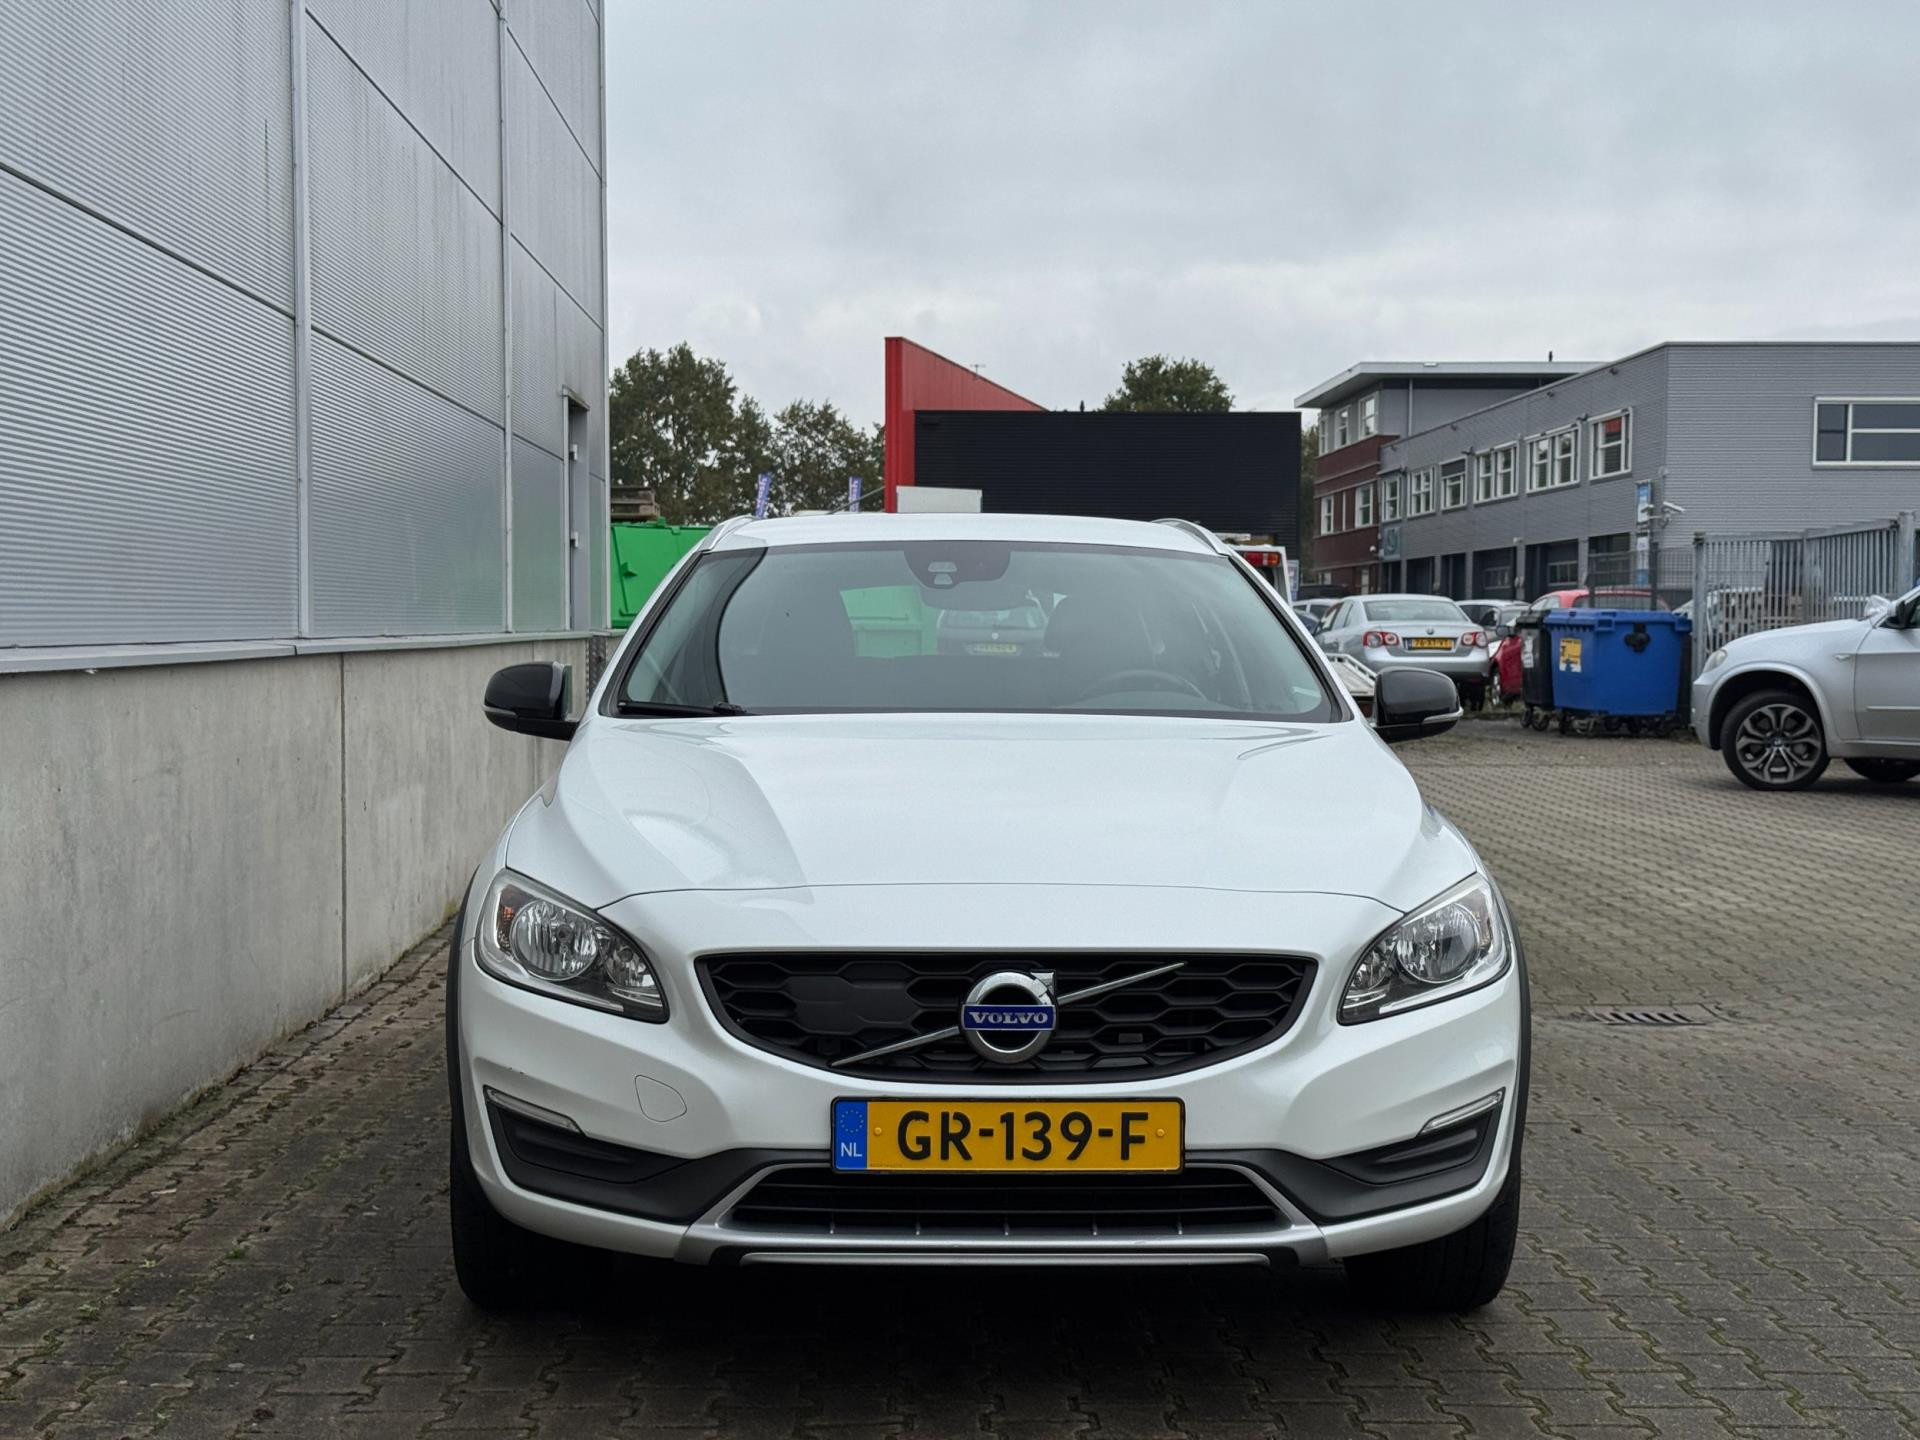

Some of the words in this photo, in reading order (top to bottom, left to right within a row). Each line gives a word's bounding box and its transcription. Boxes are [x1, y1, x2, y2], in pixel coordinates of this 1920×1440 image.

[969, 1011, 1049, 1024] VOLVO
[897, 1110, 1149, 1161] GR-139-F
[840, 1142, 862, 1157] NL
